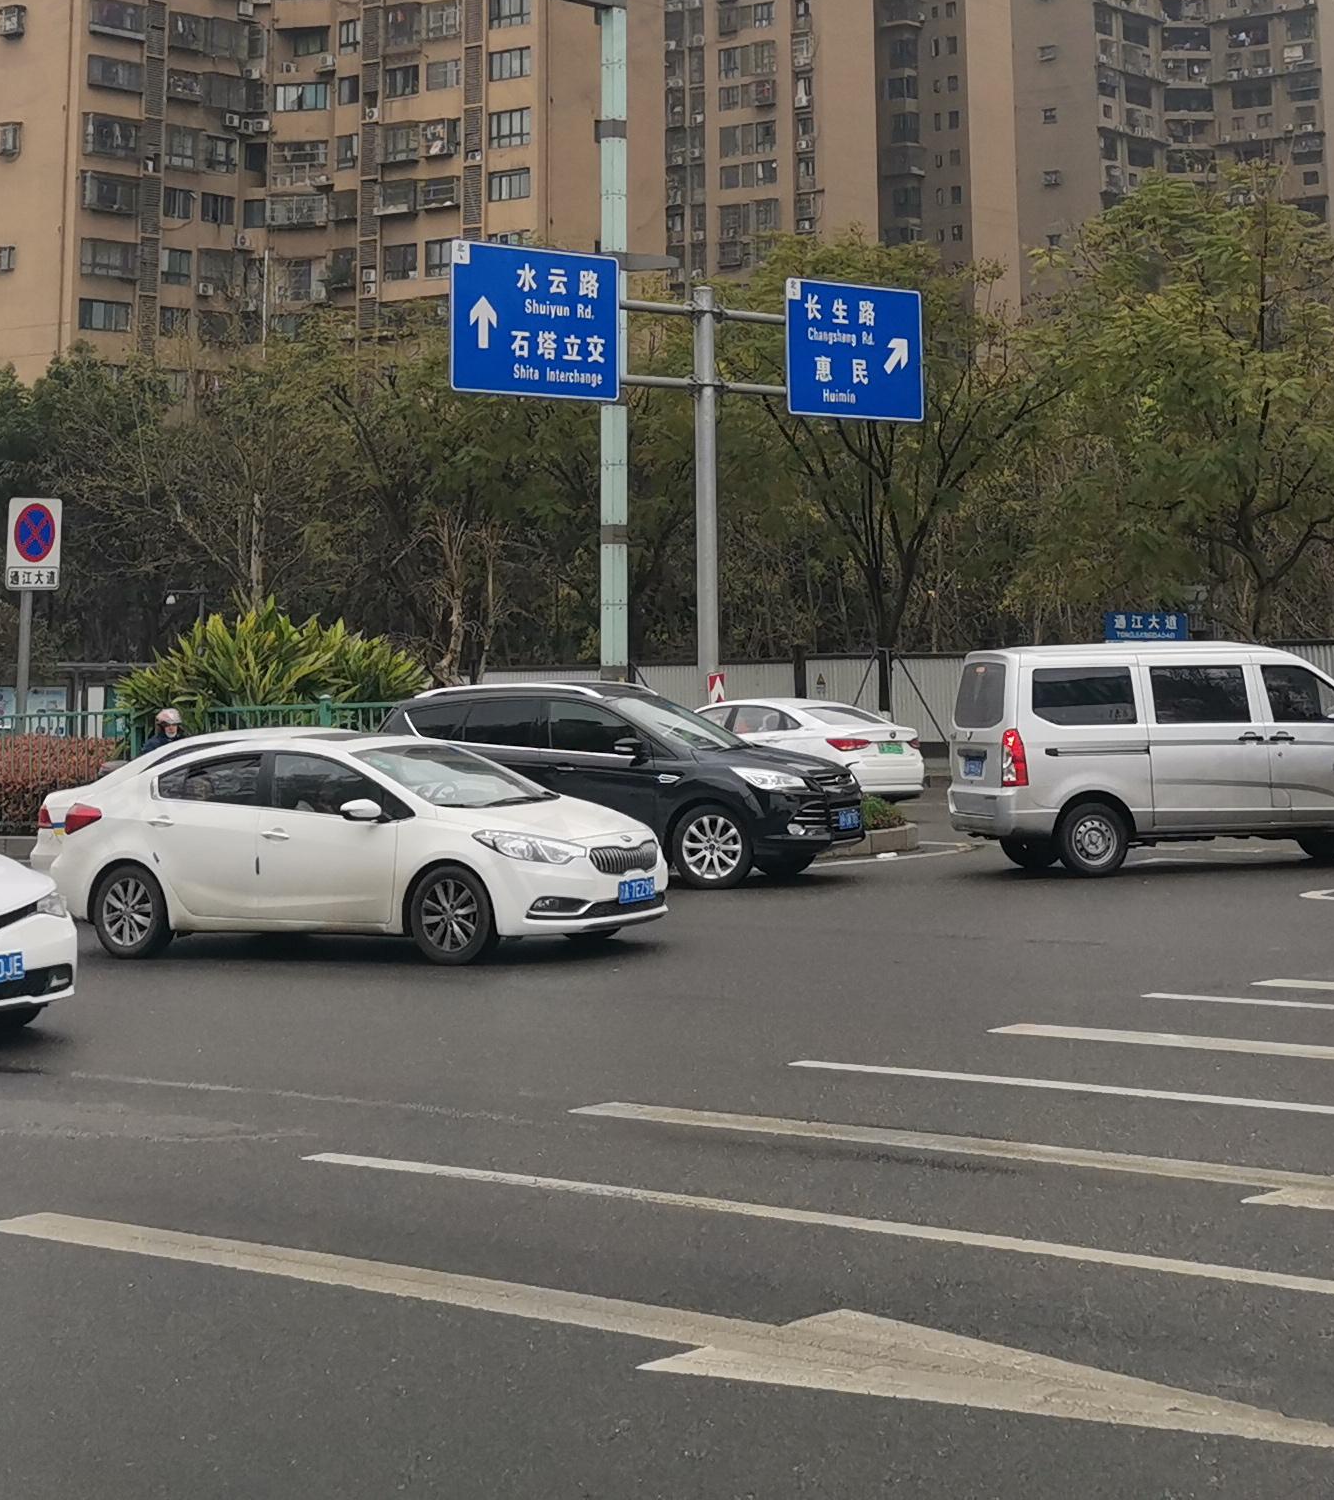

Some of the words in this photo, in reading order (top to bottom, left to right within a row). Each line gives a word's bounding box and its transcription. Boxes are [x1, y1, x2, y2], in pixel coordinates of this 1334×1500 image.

[517, 263, 600, 299] 水云路
[525, 299, 570, 319] Shuiyun
[577, 304, 595, 320] Rd.
[804, 293, 875, 326] 长生路
[511, 330, 605, 364] 石塔立交
[513, 363, 540, 380] Shita
[546, 367, 603, 387] Interchange
[814, 355, 868, 385] 惠民
